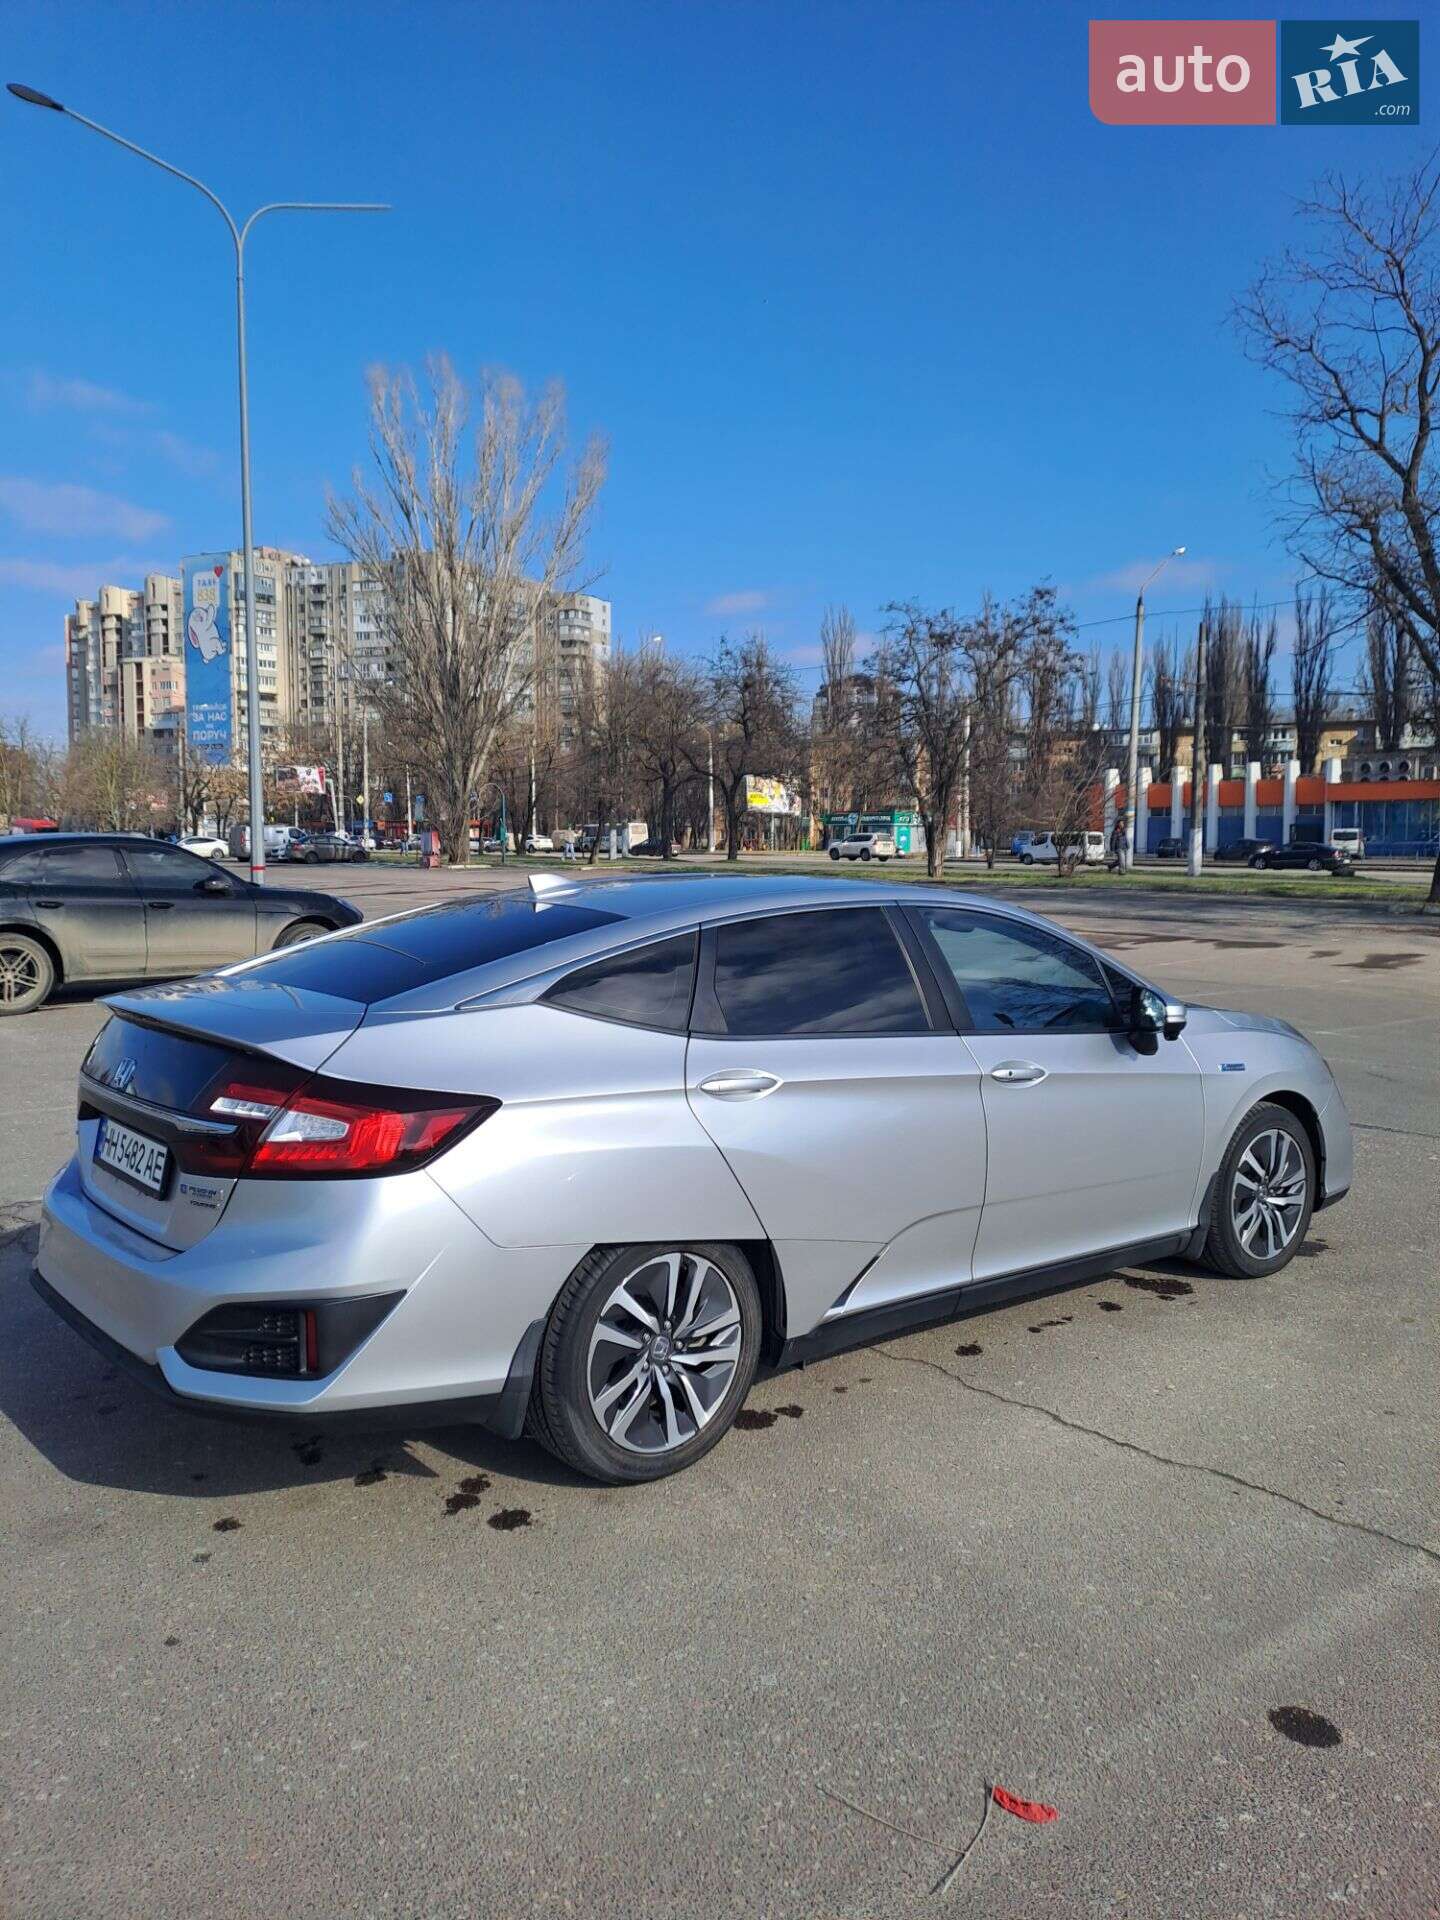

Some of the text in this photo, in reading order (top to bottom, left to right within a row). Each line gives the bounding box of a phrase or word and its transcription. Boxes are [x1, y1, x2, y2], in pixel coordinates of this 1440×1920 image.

[192, 730, 227, 741] ПОРУЧ
[118, 1134, 146, 1174] 5482
[144, 1149, 165, 1184] AE
